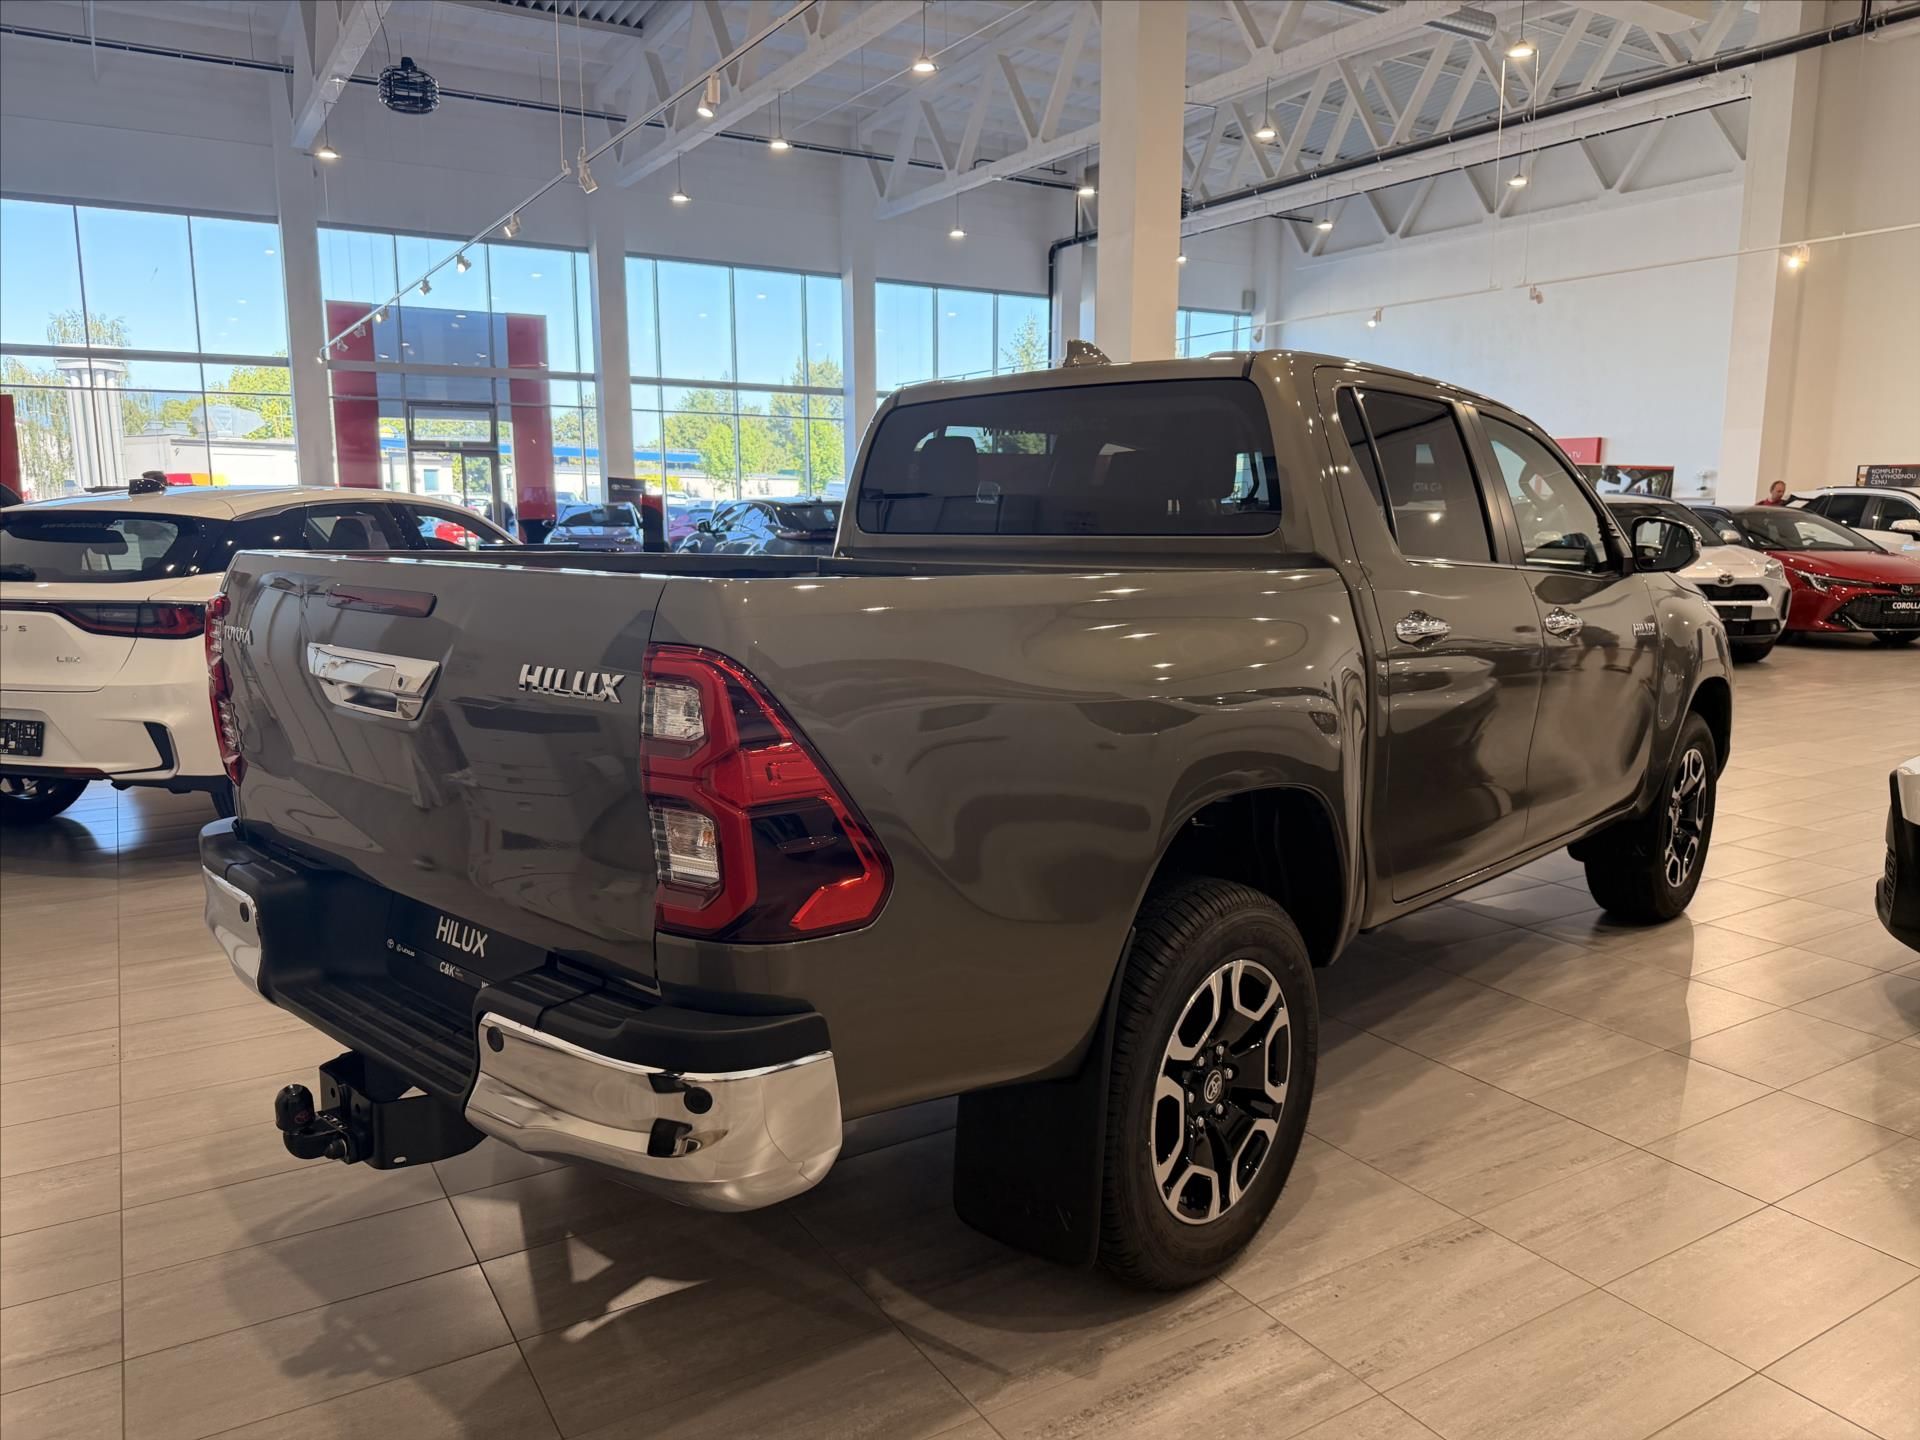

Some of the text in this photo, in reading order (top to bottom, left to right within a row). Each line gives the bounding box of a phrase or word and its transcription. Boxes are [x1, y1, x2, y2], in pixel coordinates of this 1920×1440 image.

[224, 625, 251, 645] TOYOTA
[519, 664, 625, 704] HILUX
[435, 915, 488, 958] HILUX
[439, 961, 456, 977] C&K
